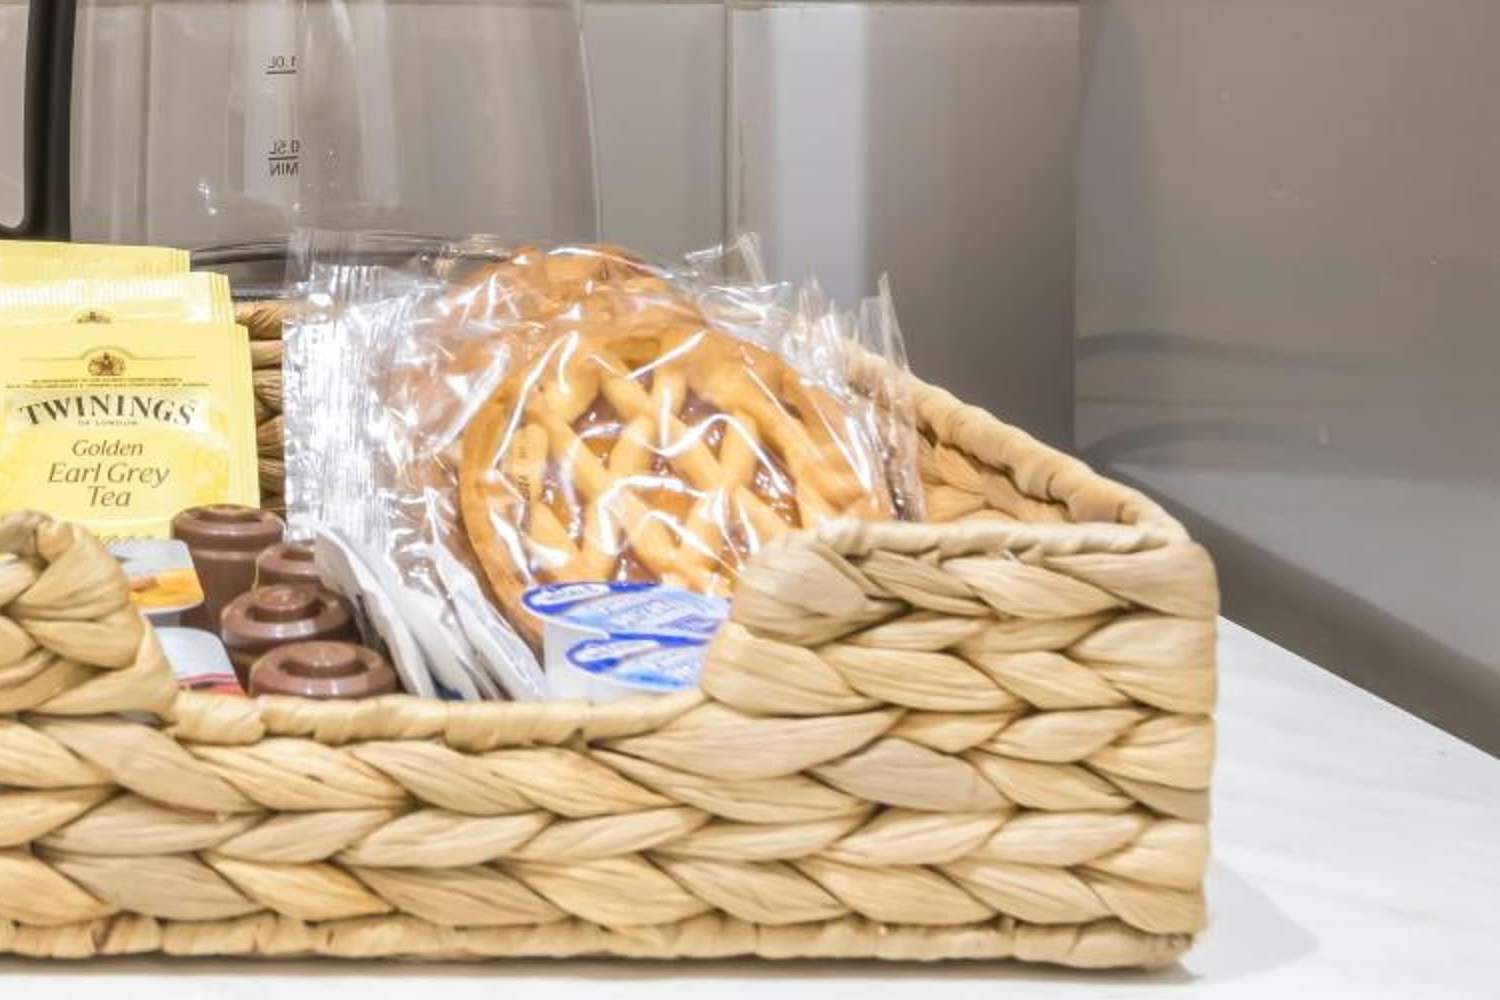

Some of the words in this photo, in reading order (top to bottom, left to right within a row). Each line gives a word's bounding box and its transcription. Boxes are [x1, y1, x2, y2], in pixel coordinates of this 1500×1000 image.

[19, 394, 196, 425] TWININGS
[72, 439, 144, 457] Golden
[48, 462, 102, 484] Earl
[107, 462, 171, 489] Grey
[88, 485, 132, 508] Tea
